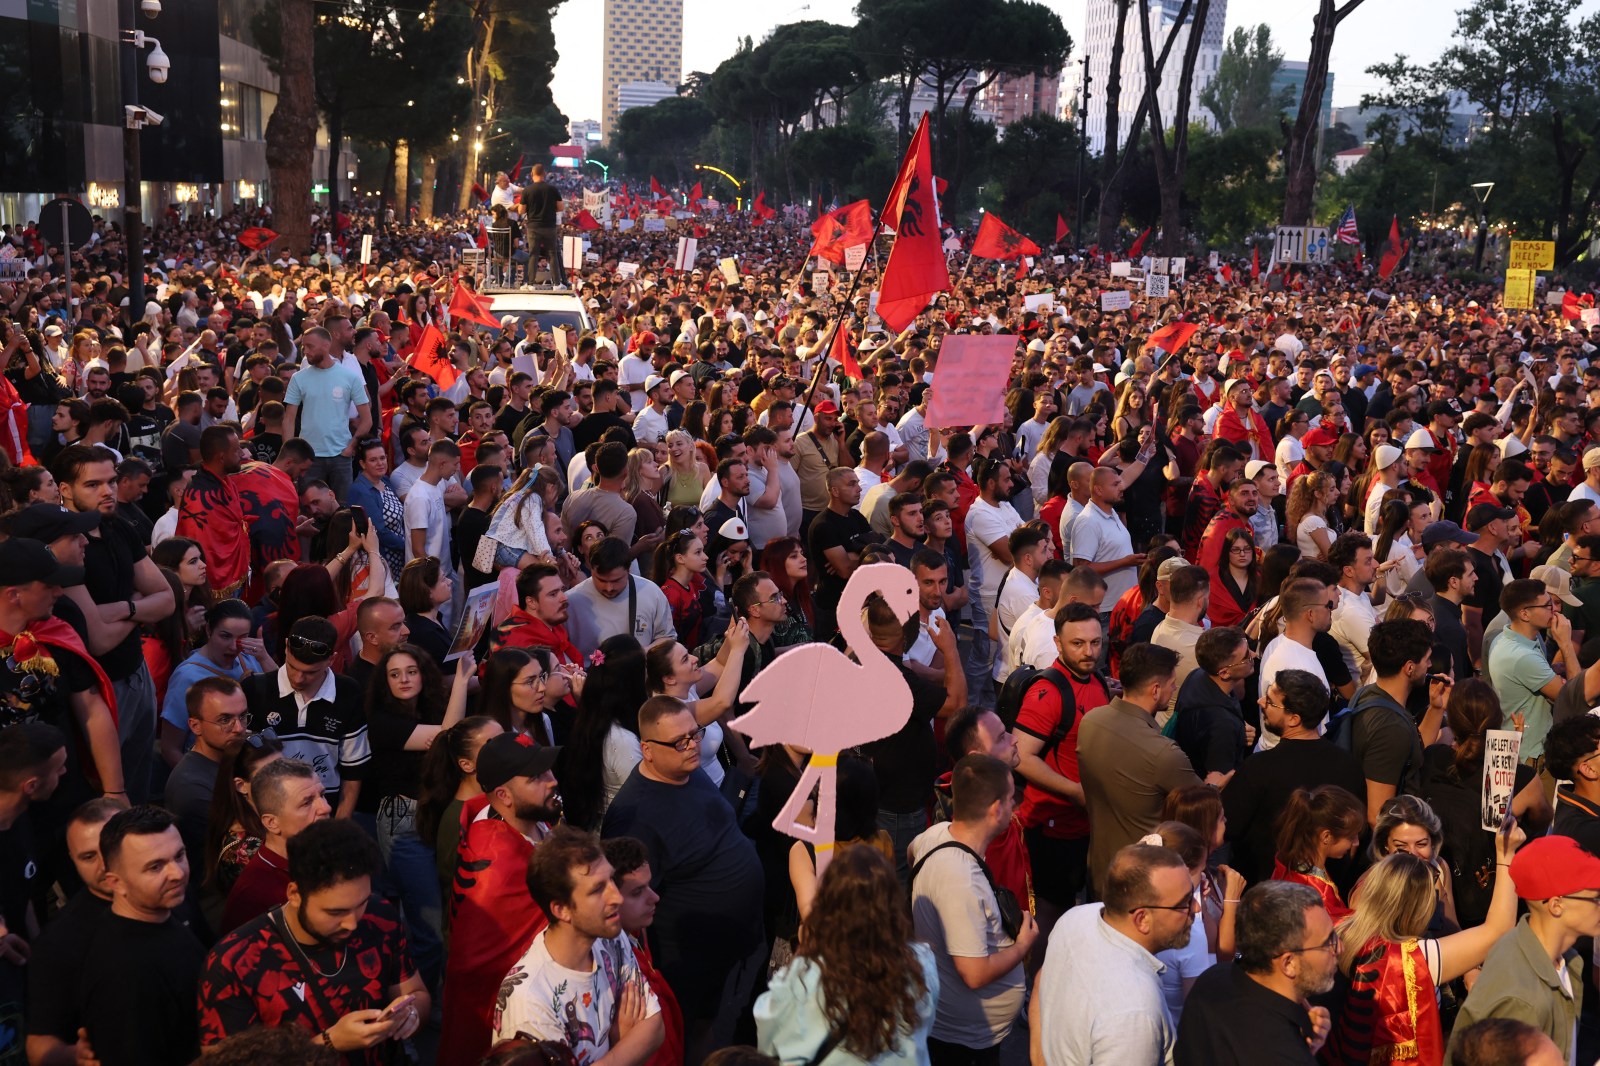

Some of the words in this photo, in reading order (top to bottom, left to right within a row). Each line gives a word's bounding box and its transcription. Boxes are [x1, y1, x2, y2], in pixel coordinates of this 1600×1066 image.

[1512, 242, 1546, 250] PLEASE
[1515, 252, 1540, 261] HELP
[1490, 738, 1498, 752] WE
[1497, 739, 1509, 752] LEFT
[1492, 754, 1500, 769] WE
[1494, 770, 1515, 787] CITIZ
